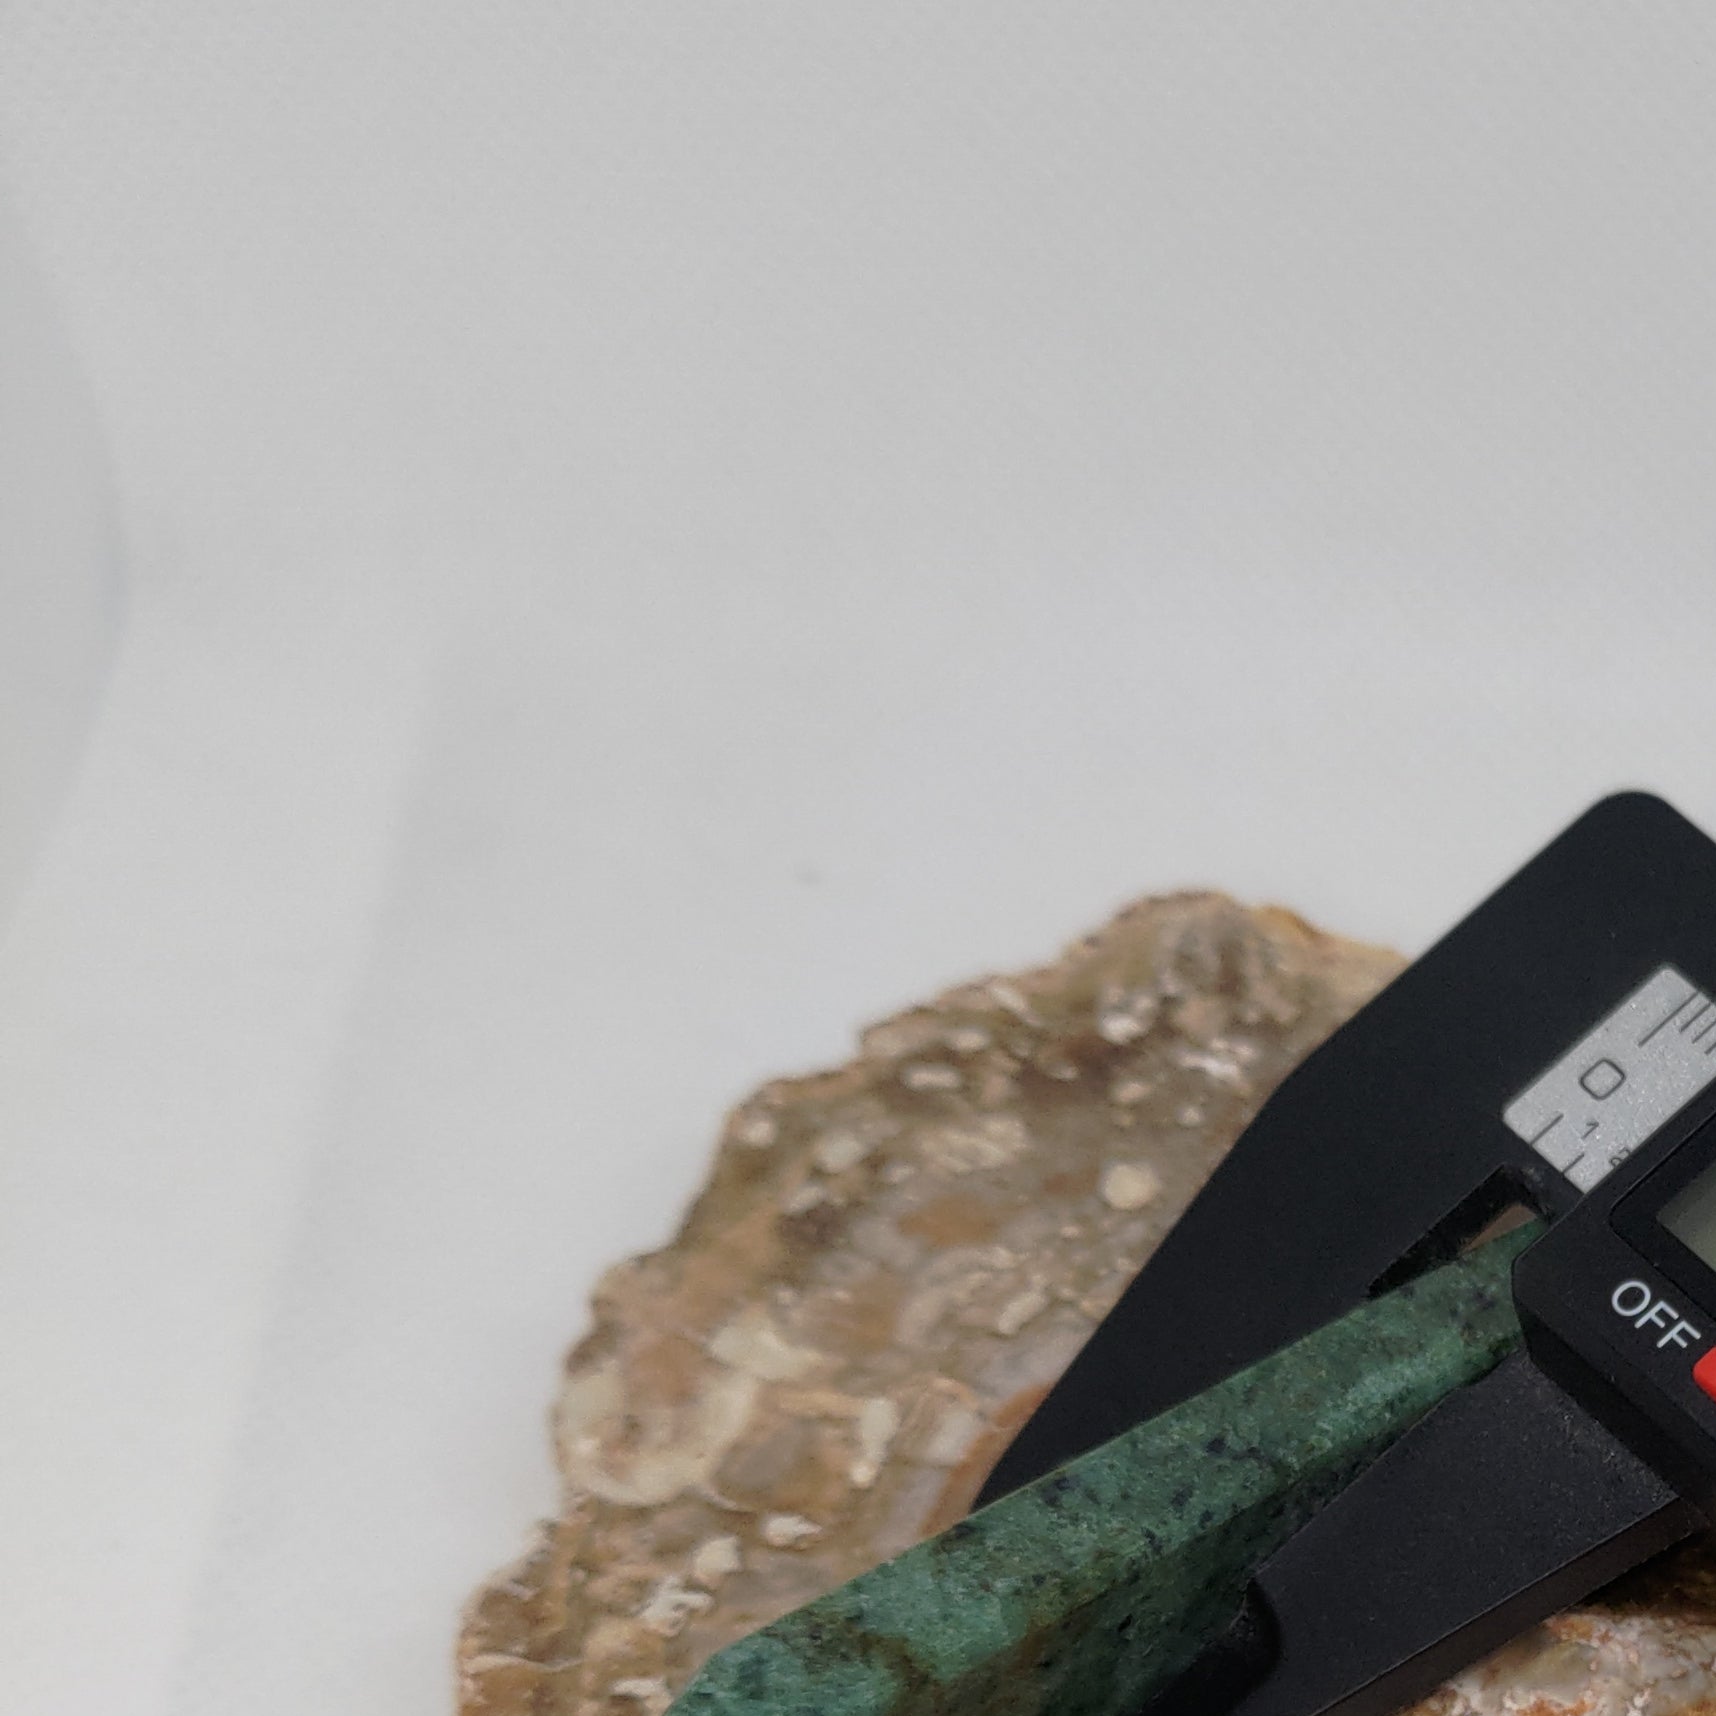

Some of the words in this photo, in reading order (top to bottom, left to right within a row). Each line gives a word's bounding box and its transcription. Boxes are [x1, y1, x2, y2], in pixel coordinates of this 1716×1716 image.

[1578, 1057, 1627, 1101] 0
[1581, 1119, 1599, 1140] 1
[1611, 1280, 1701, 1348] OFF
